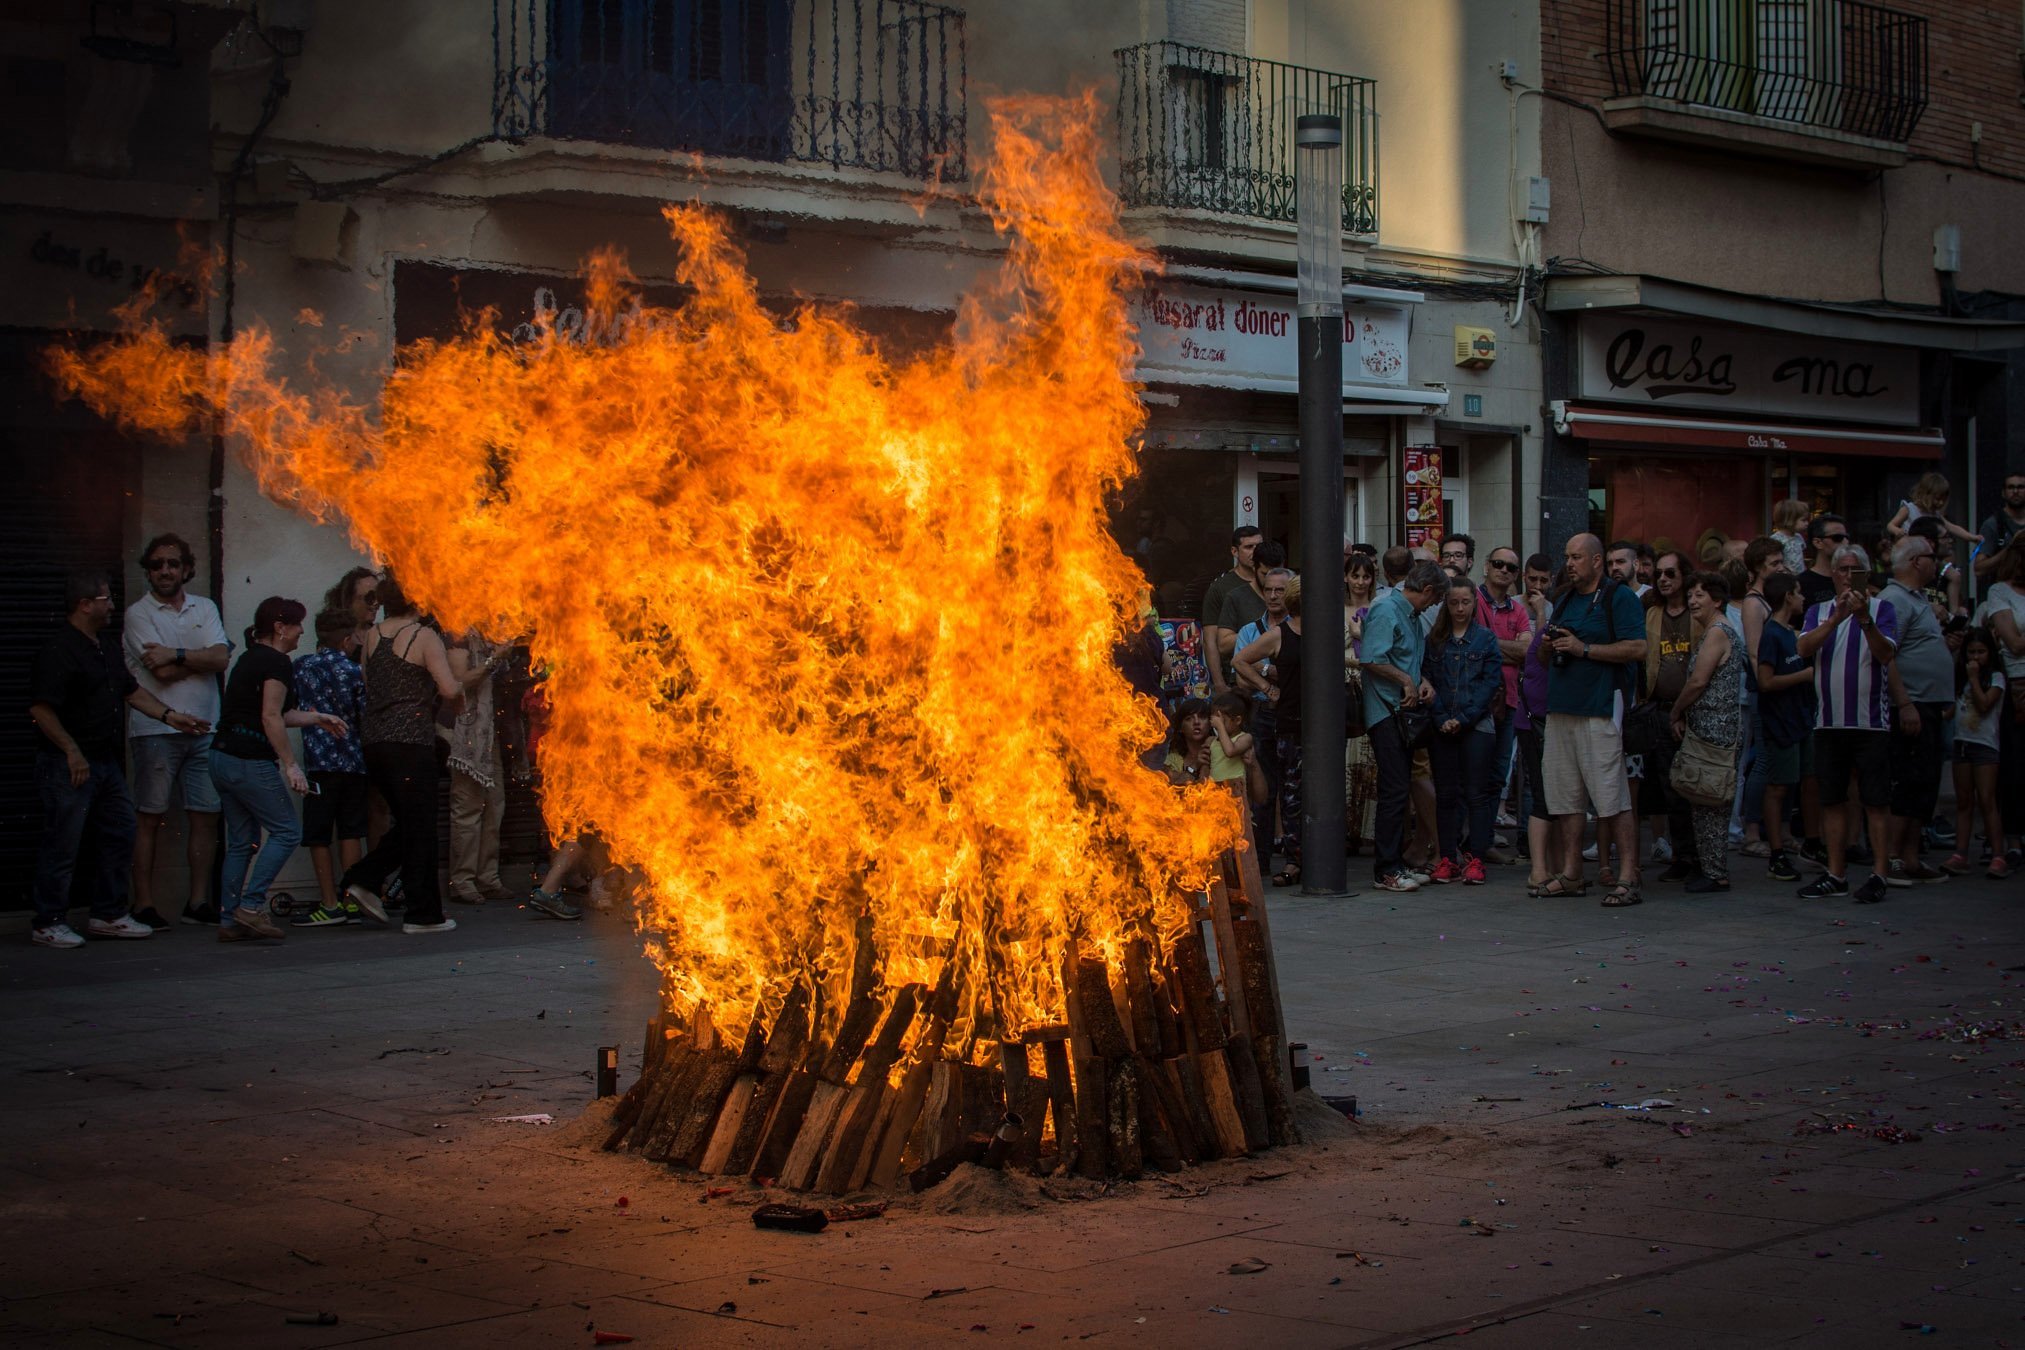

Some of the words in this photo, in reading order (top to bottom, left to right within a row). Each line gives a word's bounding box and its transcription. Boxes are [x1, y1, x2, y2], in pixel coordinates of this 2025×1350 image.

[1235, 299, 1290, 337] döner
[1181, 337, 1226, 362] Pizza
[1606, 329, 1736, 393] Casa
[1468, 398, 1479, 412] 10
[1747, 434, 1768, 448] Casa
